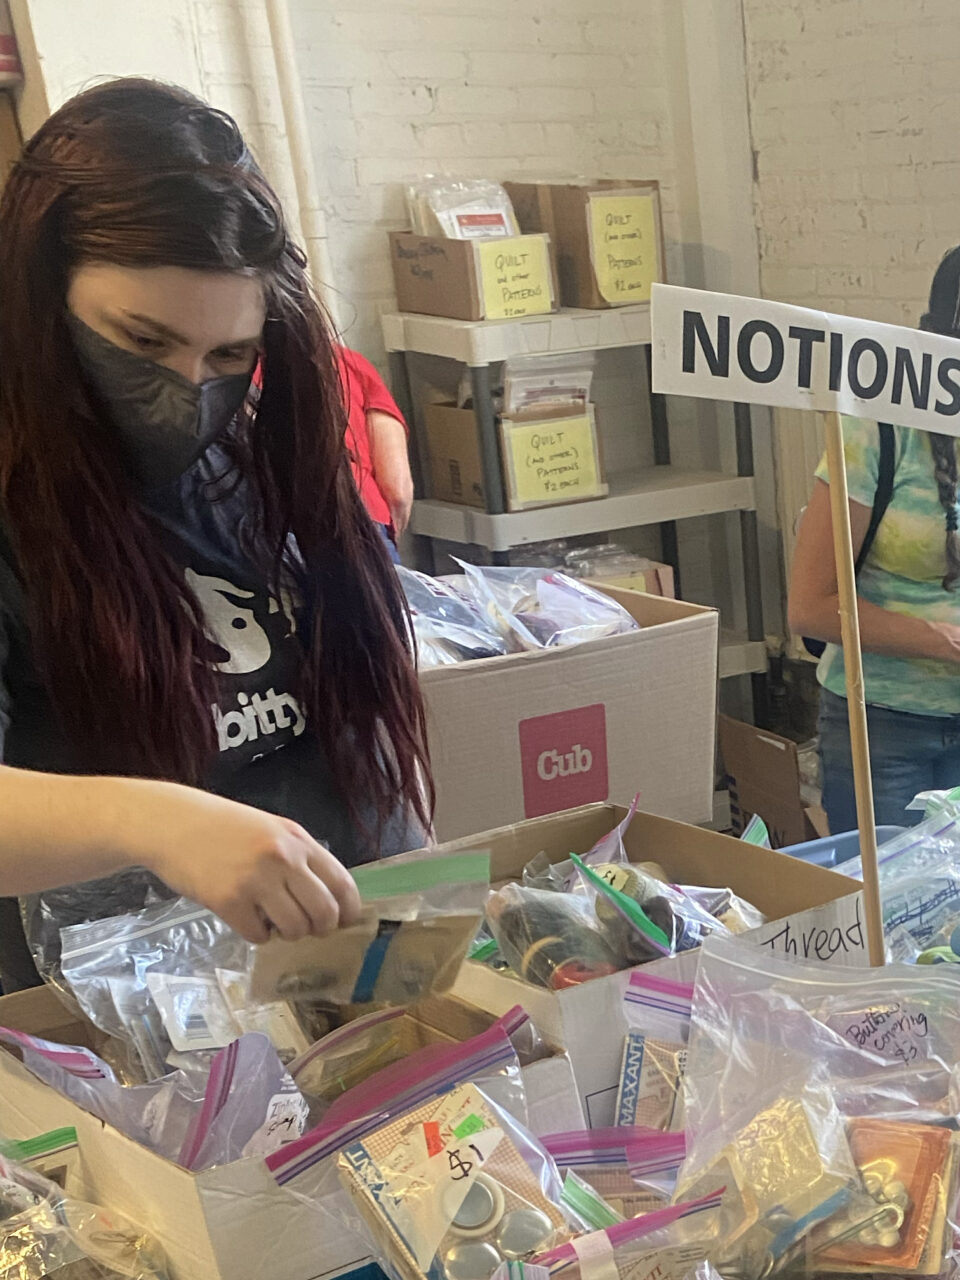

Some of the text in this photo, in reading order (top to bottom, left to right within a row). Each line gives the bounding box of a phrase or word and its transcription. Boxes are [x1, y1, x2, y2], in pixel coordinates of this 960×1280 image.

[531, 432, 565, 451] QUILT
[537, 744, 592, 780] Cub
[761, 897, 865, 960] Thread
[620, 1040, 643, 1127] MAXANT
